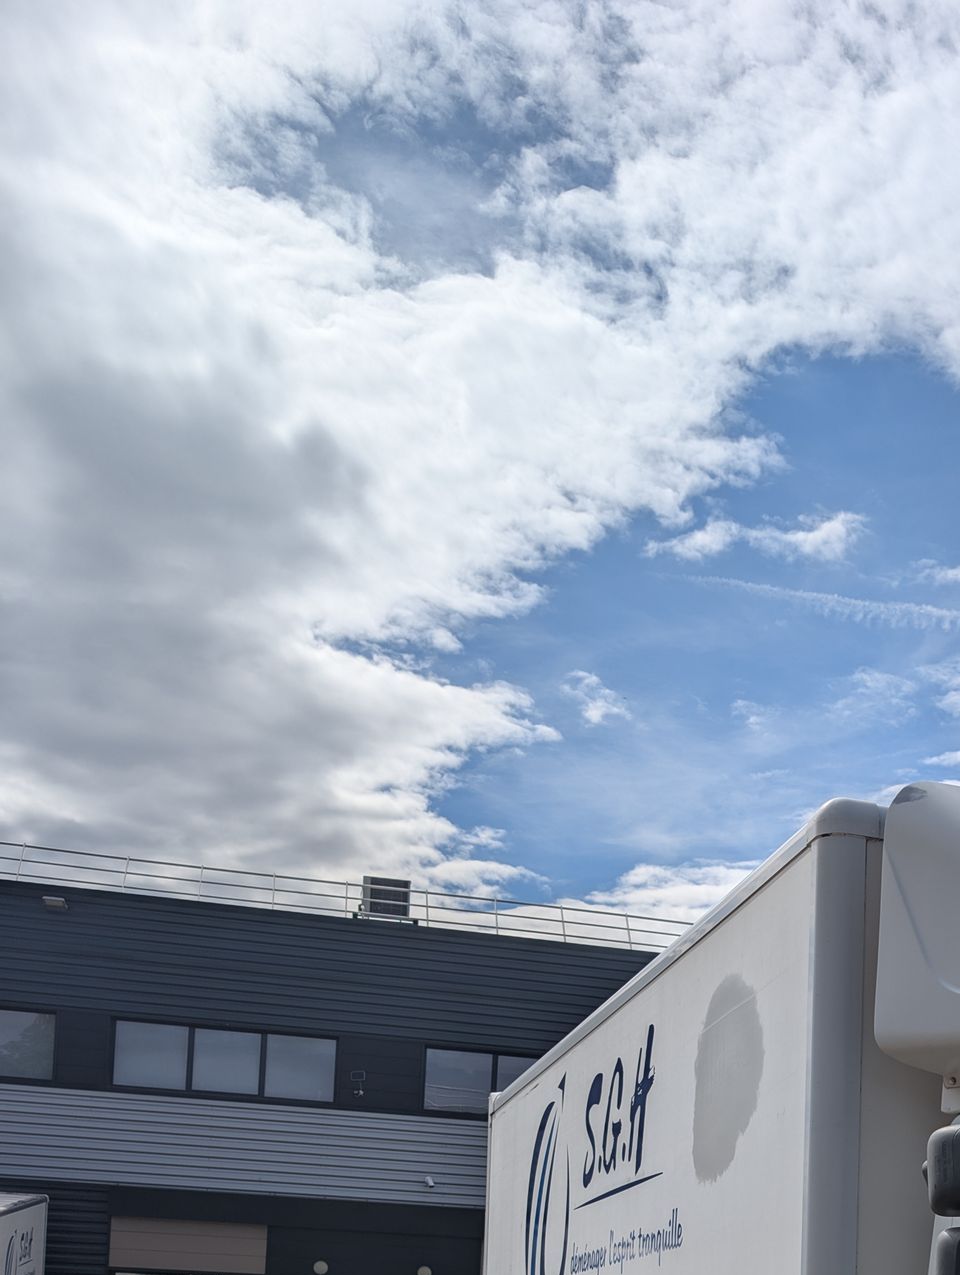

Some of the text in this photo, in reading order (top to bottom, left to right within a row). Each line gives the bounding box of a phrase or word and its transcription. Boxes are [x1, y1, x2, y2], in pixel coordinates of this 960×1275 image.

[583, 1024, 655, 1188] S.G.H
[608, 1229, 636, 1275] l'esprit
[638, 1208, 683, 1267] tranquille
